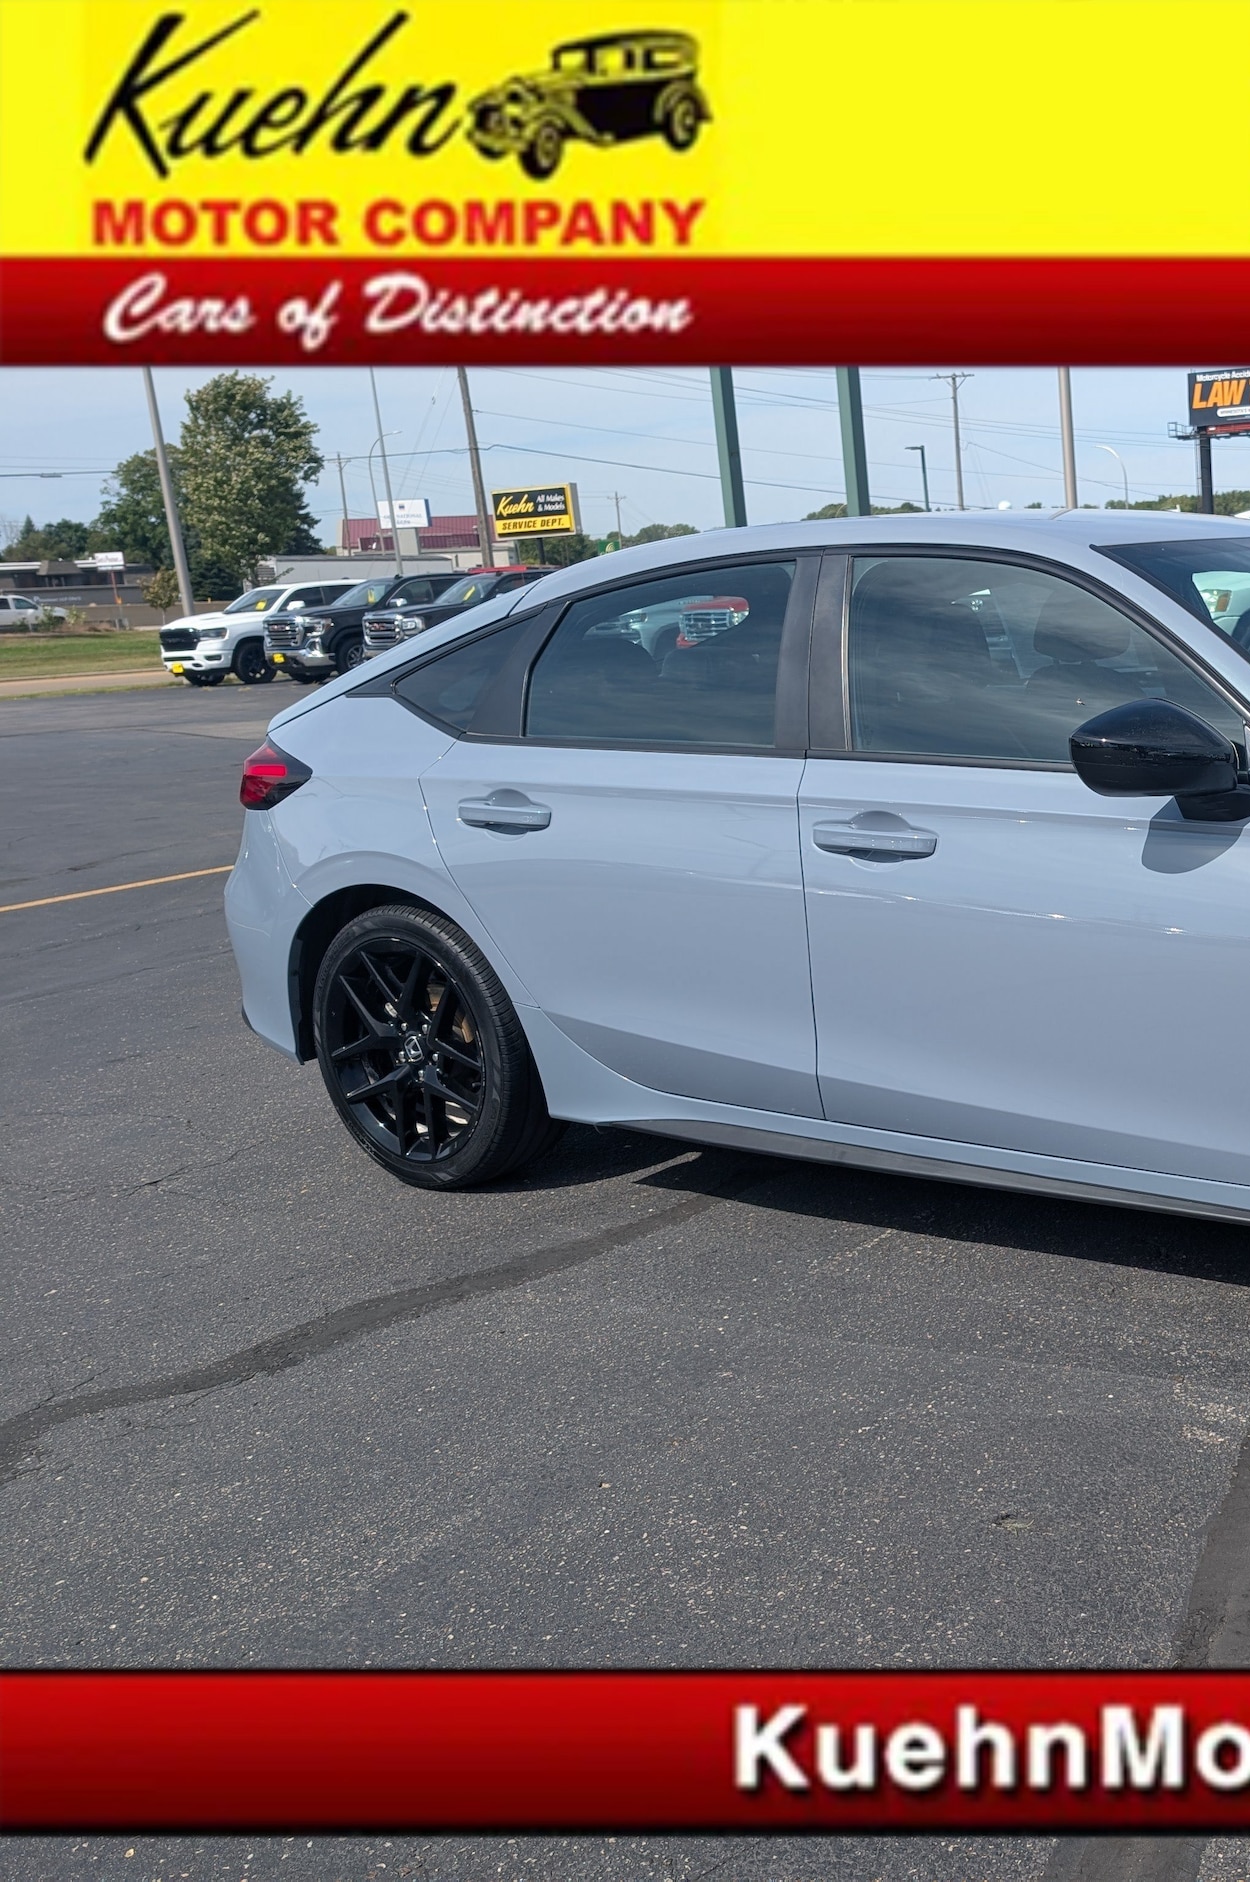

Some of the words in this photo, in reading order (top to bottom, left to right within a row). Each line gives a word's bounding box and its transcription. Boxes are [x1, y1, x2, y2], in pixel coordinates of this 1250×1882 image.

[1196, 371, 1231, 382] Motorcycle
[1192, 379, 1246, 409] LAW
[536, 495, 545, 503] All
[545, 493, 564, 502] Makes
[496, 494, 535, 517] Kuehn
[537, 504, 543, 512] &
[544, 503, 565, 511] Models
[502, 520, 537, 531] SERVICE
[540, 518, 564, 528] DEPT.
